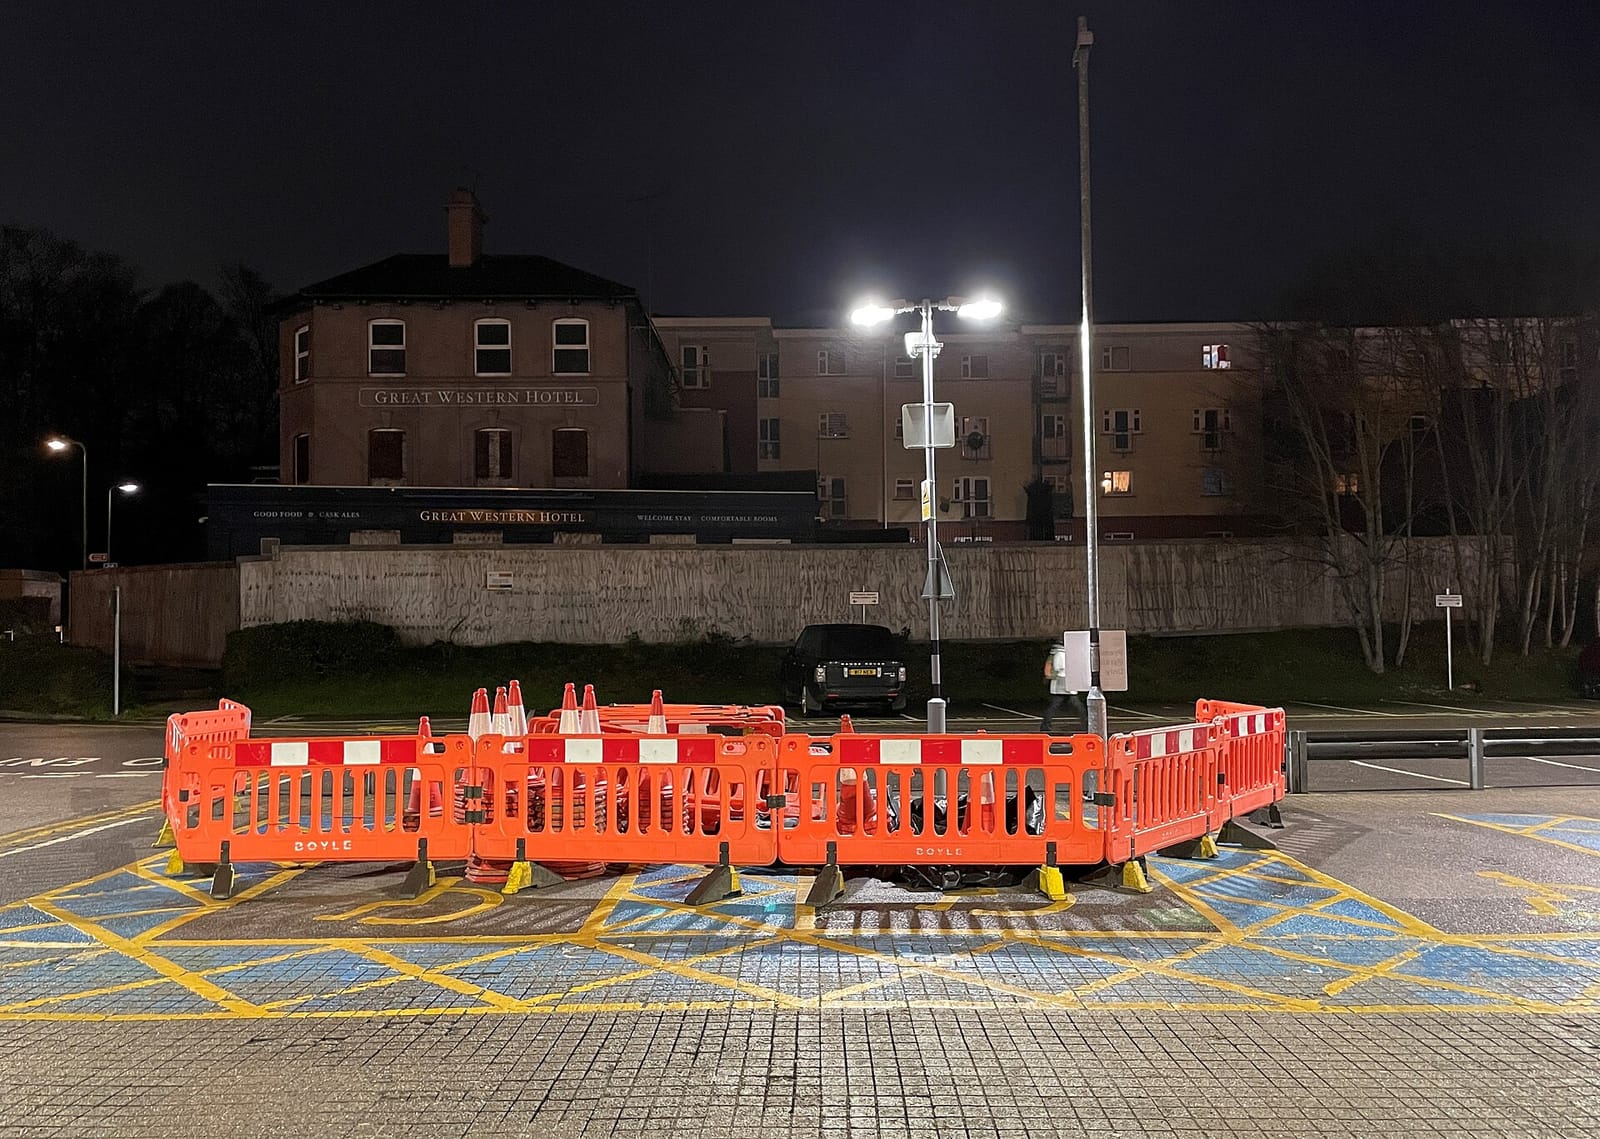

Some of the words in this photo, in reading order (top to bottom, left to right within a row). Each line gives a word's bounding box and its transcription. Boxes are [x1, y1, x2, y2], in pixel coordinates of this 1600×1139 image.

[374, 390, 432, 404] GREAT
[437, 390, 519, 404] WESTERN
[526, 390, 584, 403] HOTEL
[420, 510, 466, 522] GREAT
[470, 511, 535, 522] WESTERN
[540, 511, 585, 523] HOTEL
[294, 840, 352, 852] BOYLE
[916, 847, 962, 856] BOYLE
